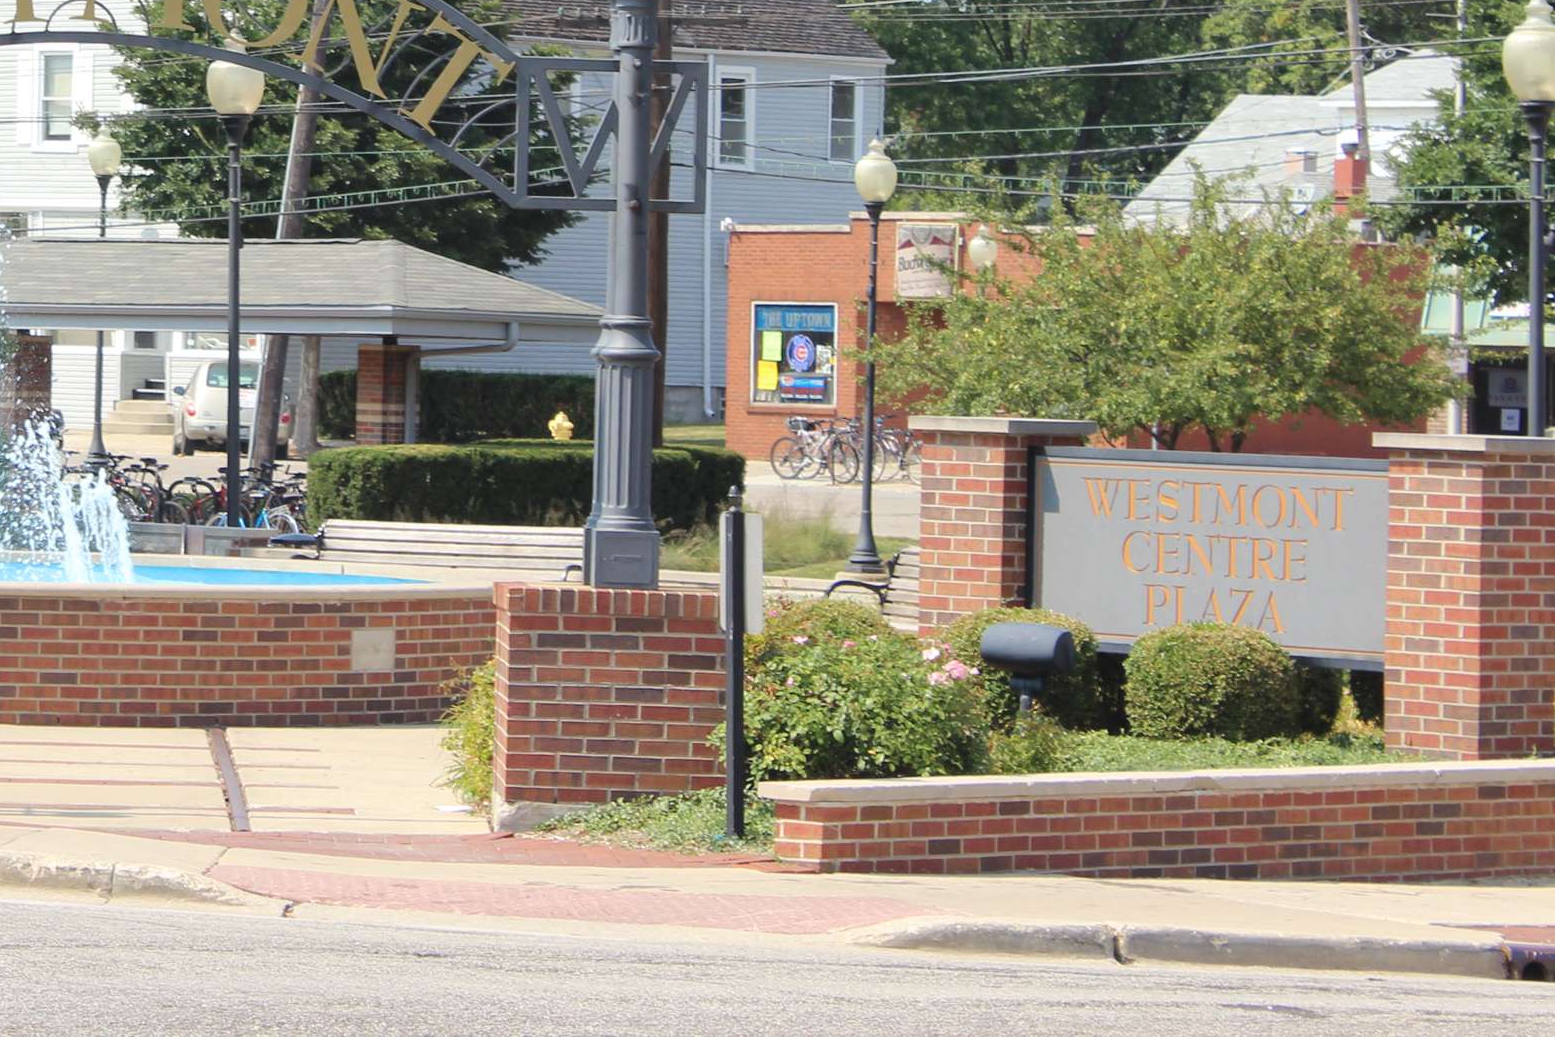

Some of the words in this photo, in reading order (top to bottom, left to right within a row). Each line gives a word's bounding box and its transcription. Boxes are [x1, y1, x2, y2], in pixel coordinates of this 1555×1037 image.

[1081, 476, 1354, 531] WESTMONT
[1122, 530, 1308, 583] CENTRE
[1142, 583, 1287, 634] PLAZA
